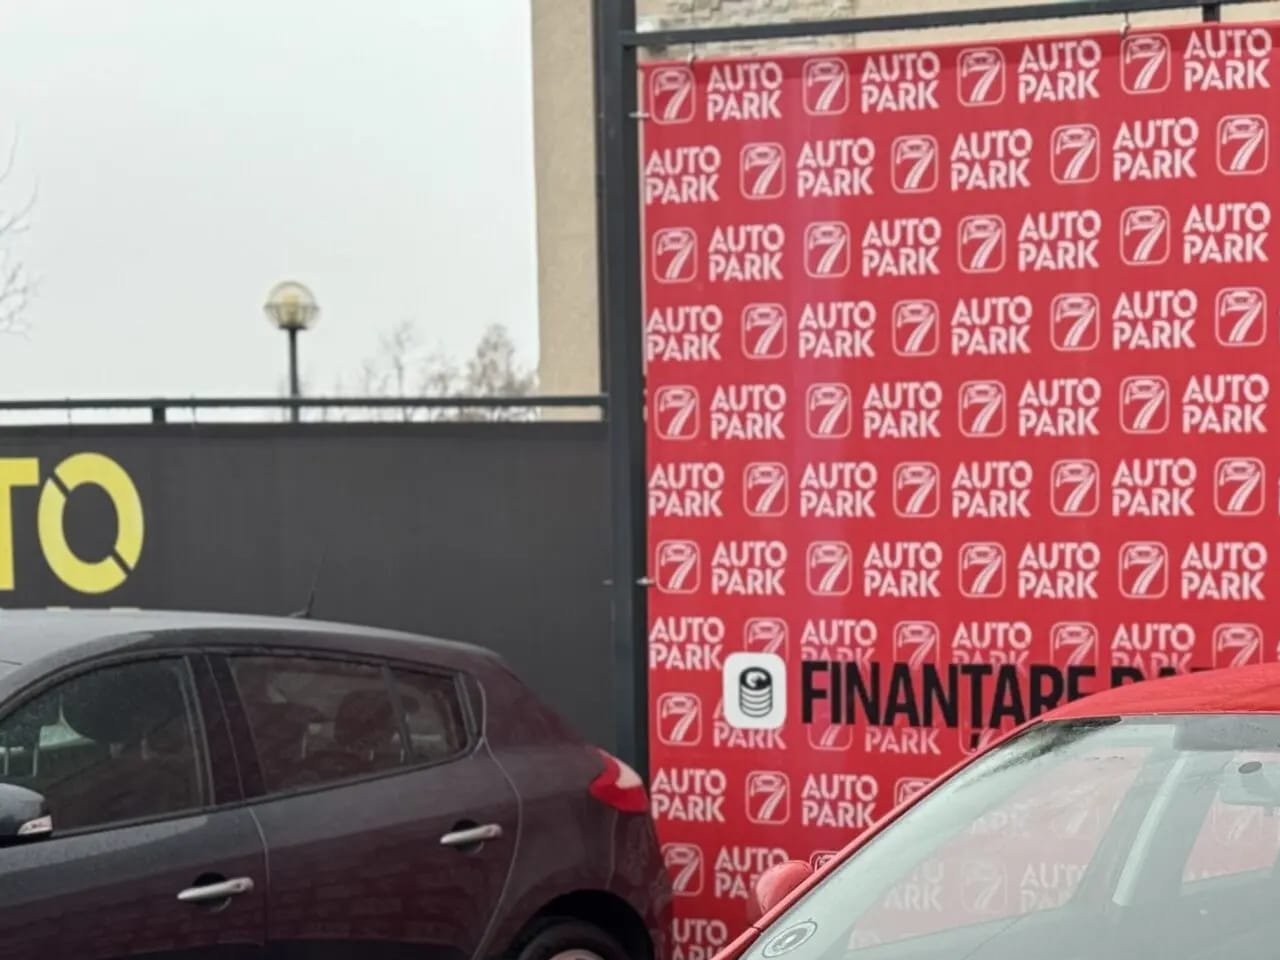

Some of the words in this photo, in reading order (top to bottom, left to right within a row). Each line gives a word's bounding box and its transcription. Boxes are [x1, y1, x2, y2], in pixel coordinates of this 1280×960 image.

[1016, 38, 1101, 73] AUTO
[1184, 28, 1272, 59] AUTO
[705, 60, 782, 93] AUTO
[859, 49, 940, 84] AUTO
[1184, 58, 1270, 91] PARK
[861, 80, 939, 113] PARK
[1018, 68, 1099, 104] PARK
[707, 90, 781, 122] PARK
[950, 128, 1033, 161] AUTO
[1113, 117, 1199, 151] AUTO
[645, 145, 720, 176] AUTO
[796, 137, 875, 170] AUTO
[1113, 147, 1197, 181] PARK
[645, 173, 719, 204] PARK
[797, 166, 874, 198] PARK
[951, 158, 1030, 191] PARK
[862, 217, 941, 248] AUTO
[1018, 209, 1101, 241] AUTO
[1183, 202, 1271, 234] AUTO
[708, 224, 785, 253] AUTO
[1183, 232, 1268, 264] PARK
[709, 251, 783, 282] PARK
[862, 246, 940, 277] PARK
[1018, 239, 1099, 272] PARK
[646, 305, 722, 333] AUTO
[798, 300, 876, 330] AUTO
[951, 295, 1032, 327] AUTO
[1112, 289, 1198, 321] AUTO
[646, 333, 721, 361] PARK
[799, 329, 875, 358] PARK
[951, 324, 1030, 356] PARK
[1113, 318, 1196, 350] PARK
[710, 384, 786, 411] AUTO
[863, 381, 942, 410] AUTO
[1018, 377, 1101, 407] AUTO
[1182, 373, 1269, 403] AUTO
[711, 412, 785, 440] PARK
[864, 410, 941, 438] PARK
[1019, 406, 1099, 437] PARK
[1183, 403, 1267, 434] PARK
[648, 462, 724, 489] AUTO
[800, 461, 877, 489] AUTO
[951, 460, 1033, 489] AUTO
[1112, 457, 1197, 487] AUTO
[648, 490, 723, 517] PARK
[800, 489, 876, 517] PARK
[952, 489, 1031, 518] PARK
[1112, 487, 1194, 516] PARK
[711, 540, 787, 567] AUTO
[864, 541, 942, 569] AUTO
[1018, 541, 1100, 570] AUTO
[1181, 542, 1268, 570] AUTO
[712, 568, 785, 595] PARK
[864, 568, 940, 597] PARK
[1018, 570, 1098, 599] PARK
[1181, 570, 1265, 600] PARK
[650, 617, 725, 643] AUTO
[800, 618, 877, 647] AUTO
[952, 622, 1031, 649] AUTO
[1111, 623, 1196, 650] AUTO
[864, 727, 941, 755] PARK
[650, 768, 727, 795] AUTO
[801, 773, 878, 801] AUTO
[651, 794, 725, 822] PARK
[672, 918, 728, 945] UTO
